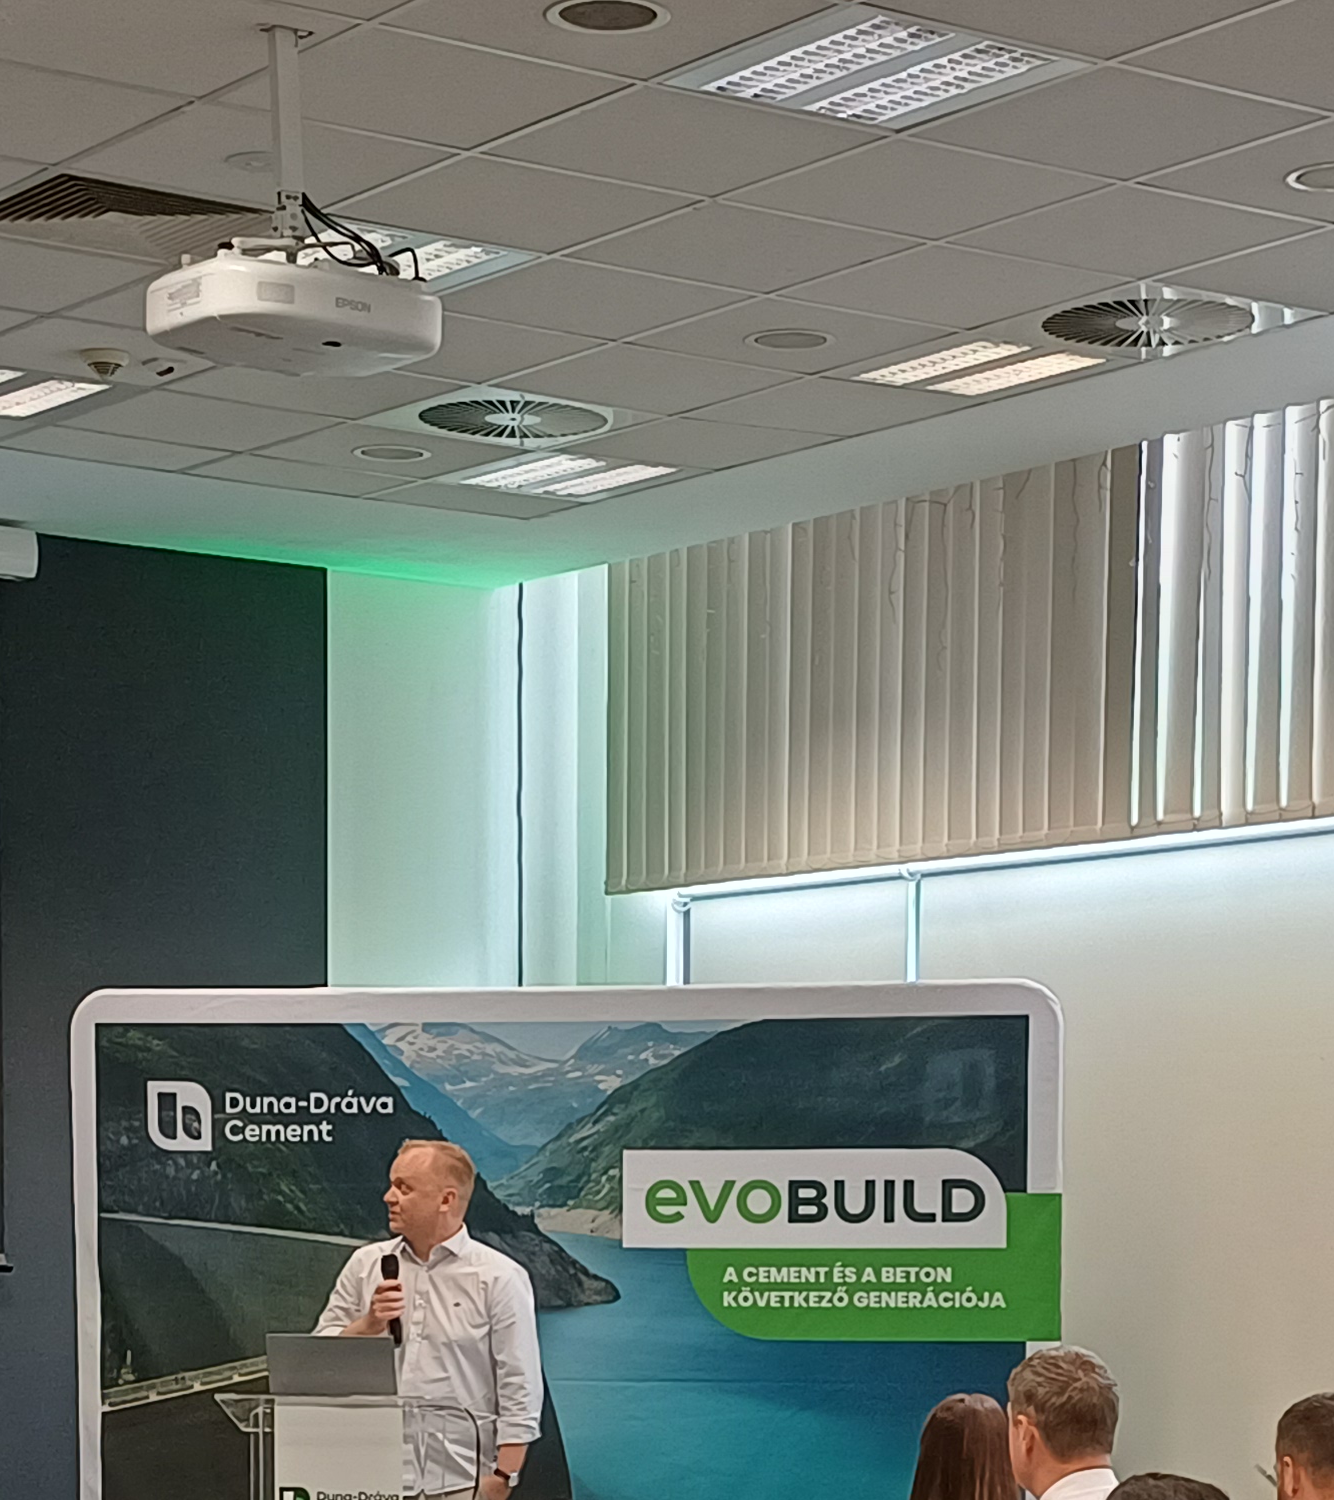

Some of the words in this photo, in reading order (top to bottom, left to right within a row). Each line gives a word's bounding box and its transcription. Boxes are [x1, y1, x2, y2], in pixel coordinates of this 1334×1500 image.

[335, 296, 371, 314] EPSON
[225, 1089, 394, 1114] Duna-Dráva
[224, 1119, 333, 1142] Cement
[645, 1178, 986, 1224] evoBUILD
[722, 1267, 738, 1283] A
[742, 1267, 829, 1283] CEMENT
[833, 1262, 857, 1283] ÉS
[861, 1267, 877, 1283] A
[881, 1267, 952, 1283] BETON
[723, 1287, 849, 1308] KÖVETKEZŐ
[853, 1287, 1006, 1308] GENERÁCIÓJA
